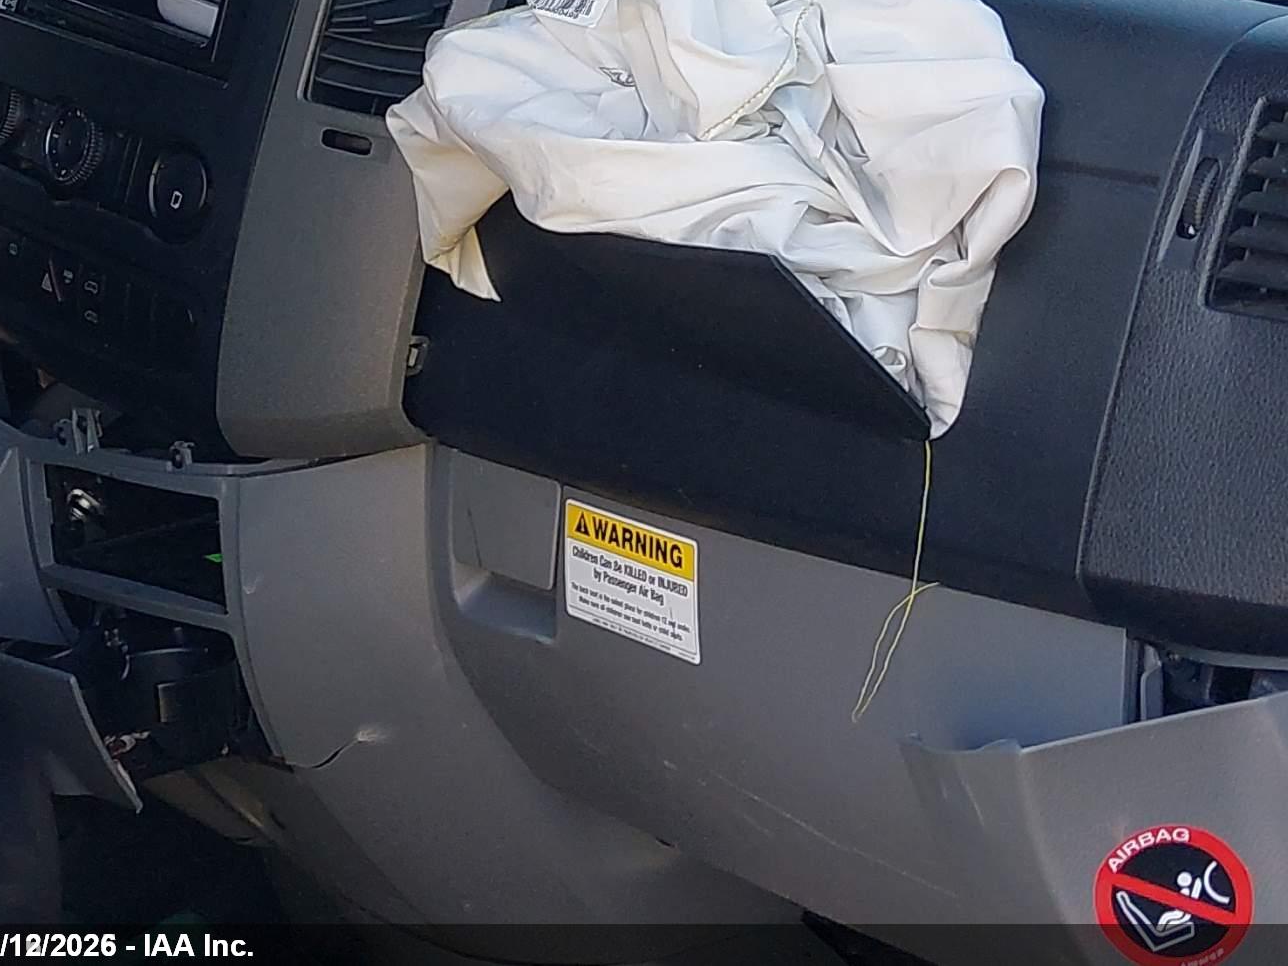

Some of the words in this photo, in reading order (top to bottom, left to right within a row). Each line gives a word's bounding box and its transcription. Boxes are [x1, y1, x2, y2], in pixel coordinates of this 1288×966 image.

[592, 516, 683, 569] WARNING
[593, 567, 601, 582] by
[639, 584, 649, 598] Air
[650, 588, 664, 606] Bag
[624, 564, 647, 582] KILLED
[1108, 827, 1190, 874] AIRBAG
